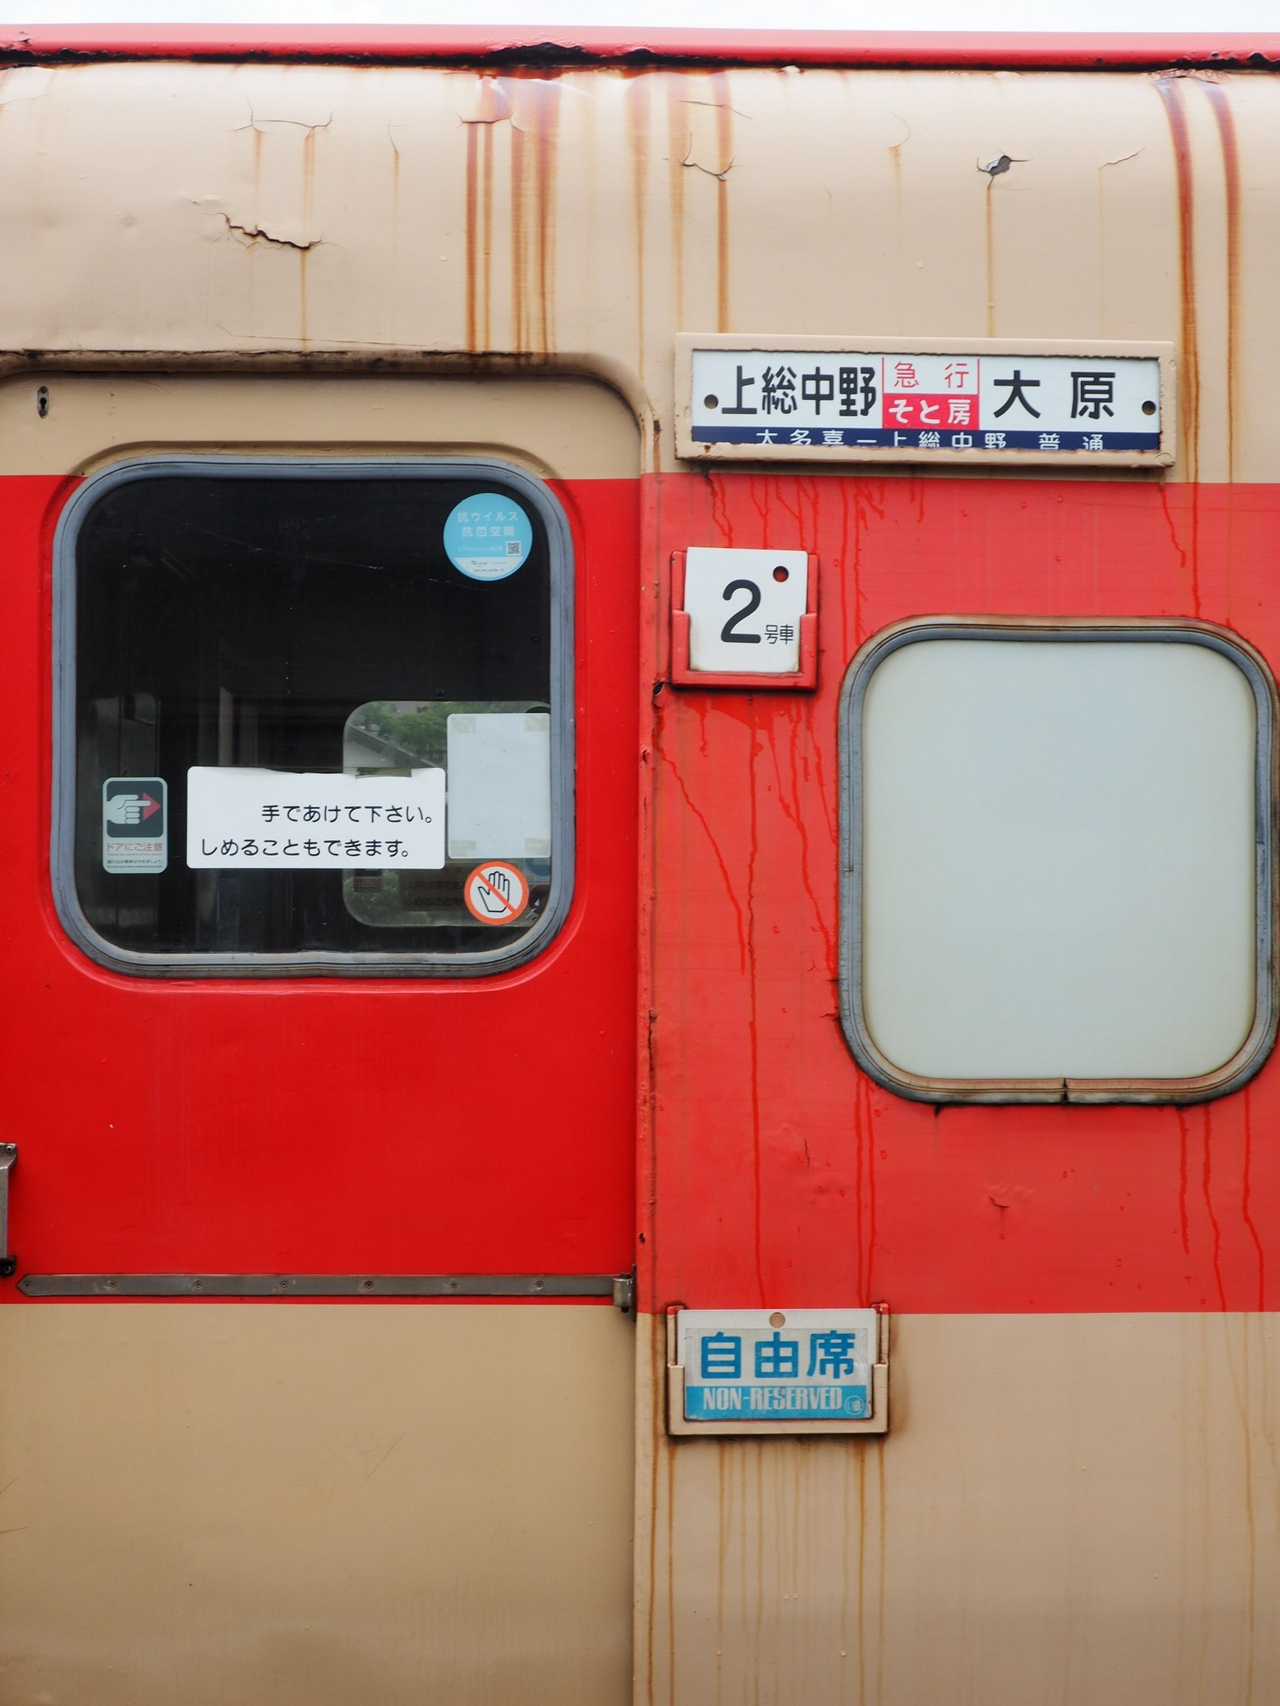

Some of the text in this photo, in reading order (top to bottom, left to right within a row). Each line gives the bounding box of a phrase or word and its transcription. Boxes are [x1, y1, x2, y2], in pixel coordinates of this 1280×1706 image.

[892, 362, 970, 389] 急行
[721, 365, 876, 417] 上総中野
[992, 369, 1116, 419] 大原
[888, 399, 972, 426] そと房
[457, 511, 518, 523] 抗ウイルス
[261, 804, 433, 824] 手であけて下さい。
[107, 842, 163, 852] ドアにご注意
[201, 838, 409, 858] しめることもできます。
[700, 1329, 856, 1379] 自由席
[703, 1387, 843, 1411] NON-RESERVED
